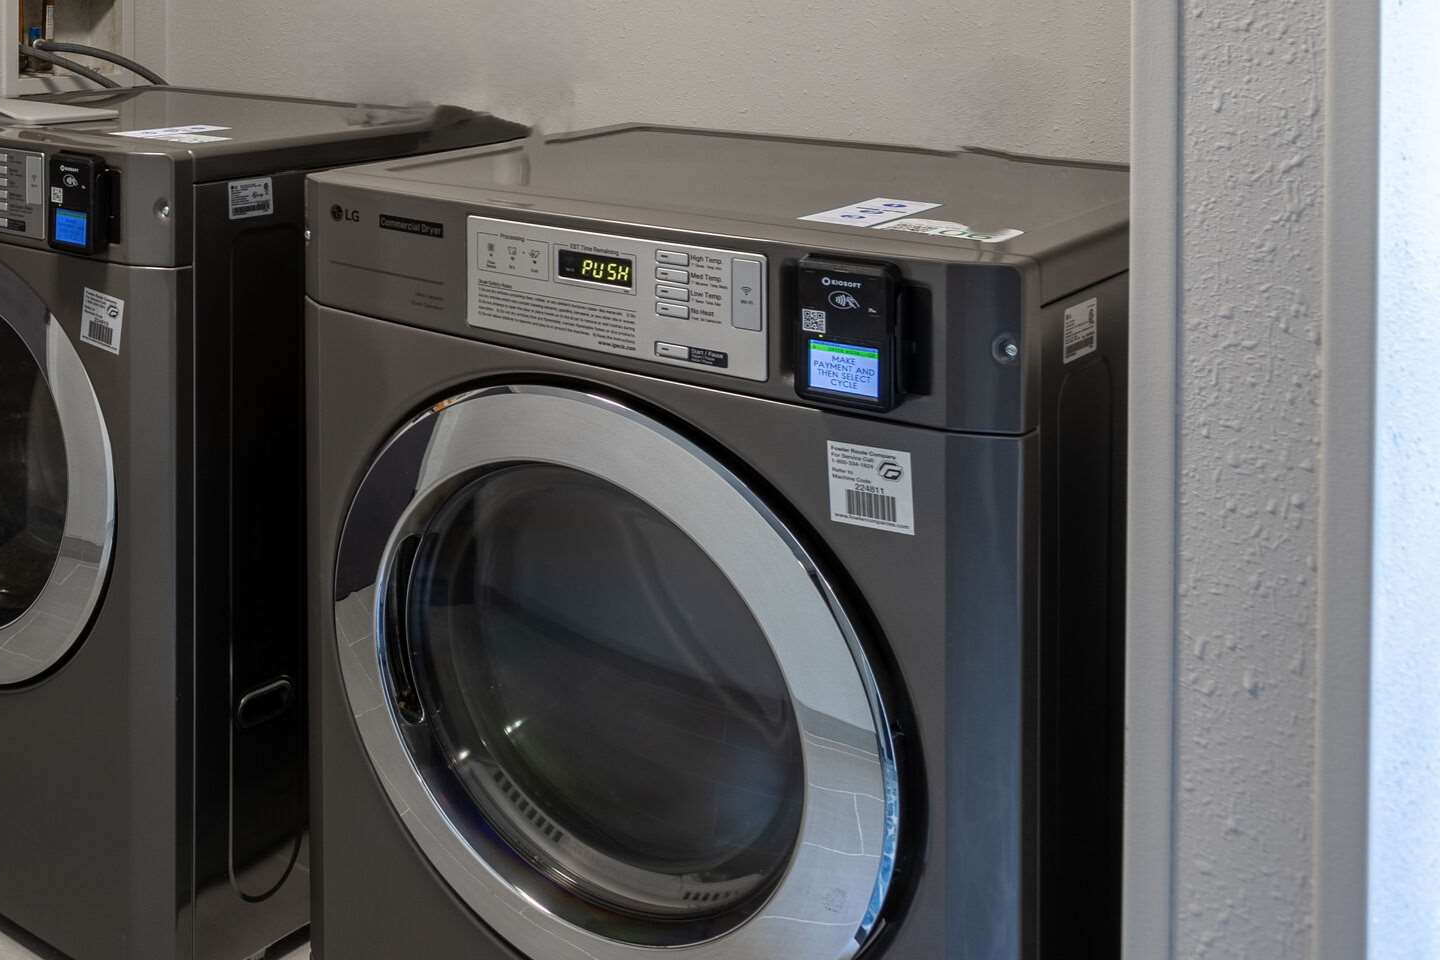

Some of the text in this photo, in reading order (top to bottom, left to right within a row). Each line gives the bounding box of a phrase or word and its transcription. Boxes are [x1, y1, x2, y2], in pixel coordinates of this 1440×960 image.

[345, 208, 360, 222] LG
[380, 217, 442, 236] Commercial Dryer
[593, 246, 620, 256] Remaining
[690, 254, 722, 265] High Temp
[582, 259, 630, 281] PUSH
[690, 272, 721, 283] Med Temp
[831, 280, 861, 289] KIOSOFT
[690, 290, 722, 301] Low Temp
[832, 355, 856, 366] MAKE
[813, 360, 876, 377] PAYMENT AND
[817, 368, 871, 384] THEN SELECT
[830, 379, 858, 390] CYCLE
